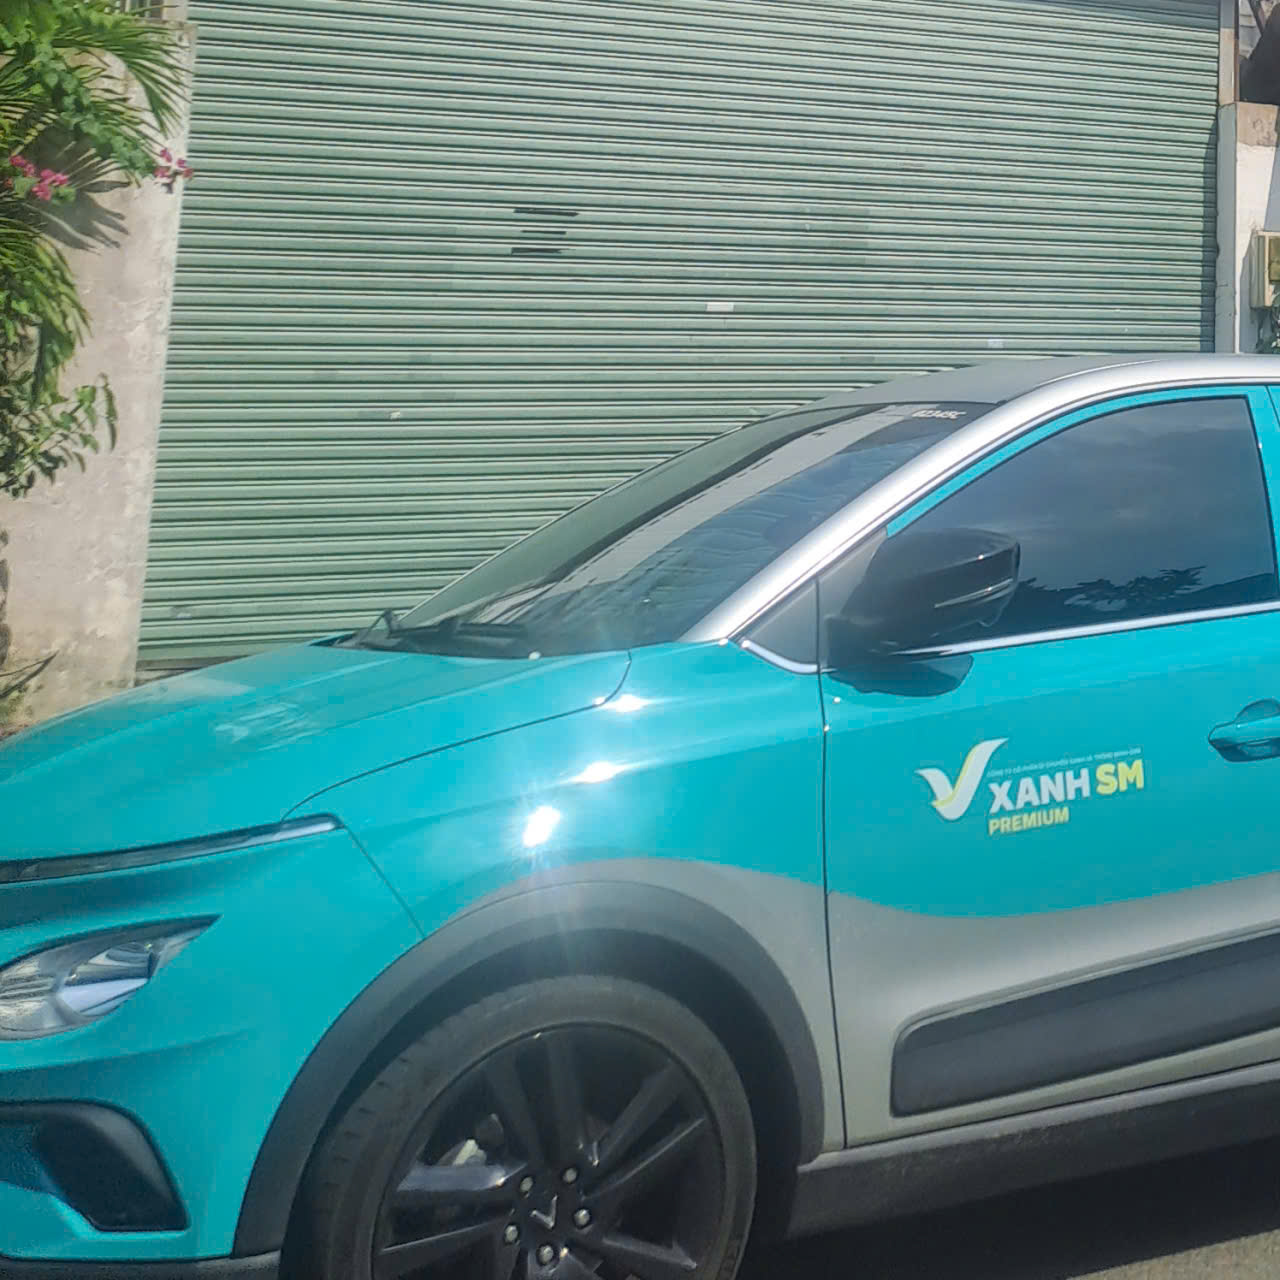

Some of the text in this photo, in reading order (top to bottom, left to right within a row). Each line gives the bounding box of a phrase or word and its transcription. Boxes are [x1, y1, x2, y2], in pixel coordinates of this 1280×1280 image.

[988, 768, 1090, 814] XANH
[1095, 759, 1144, 795] SM
[988, 806, 1069, 836] PREMIUM
